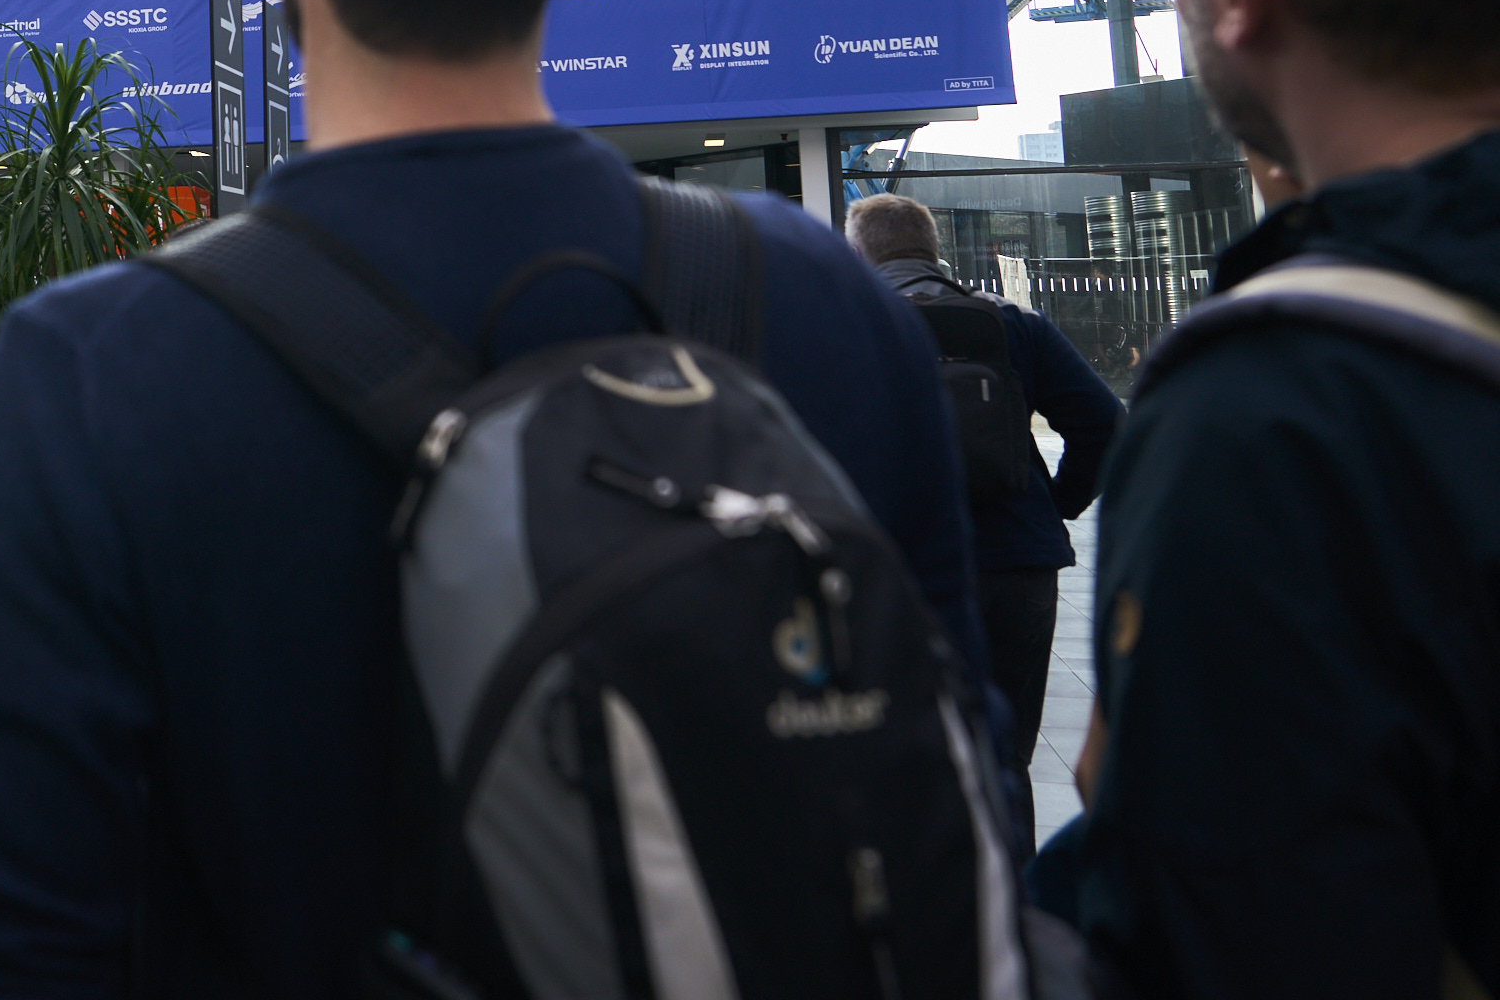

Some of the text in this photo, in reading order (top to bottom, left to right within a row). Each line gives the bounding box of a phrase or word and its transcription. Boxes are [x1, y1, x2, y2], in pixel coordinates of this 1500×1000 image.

[103, 7, 168, 27] SSSTC
[699, 40, 770, 58] XINSUN
[838, 35, 939, 54] YUAN DEAN
[551, 55, 628, 72] WINSTAR
